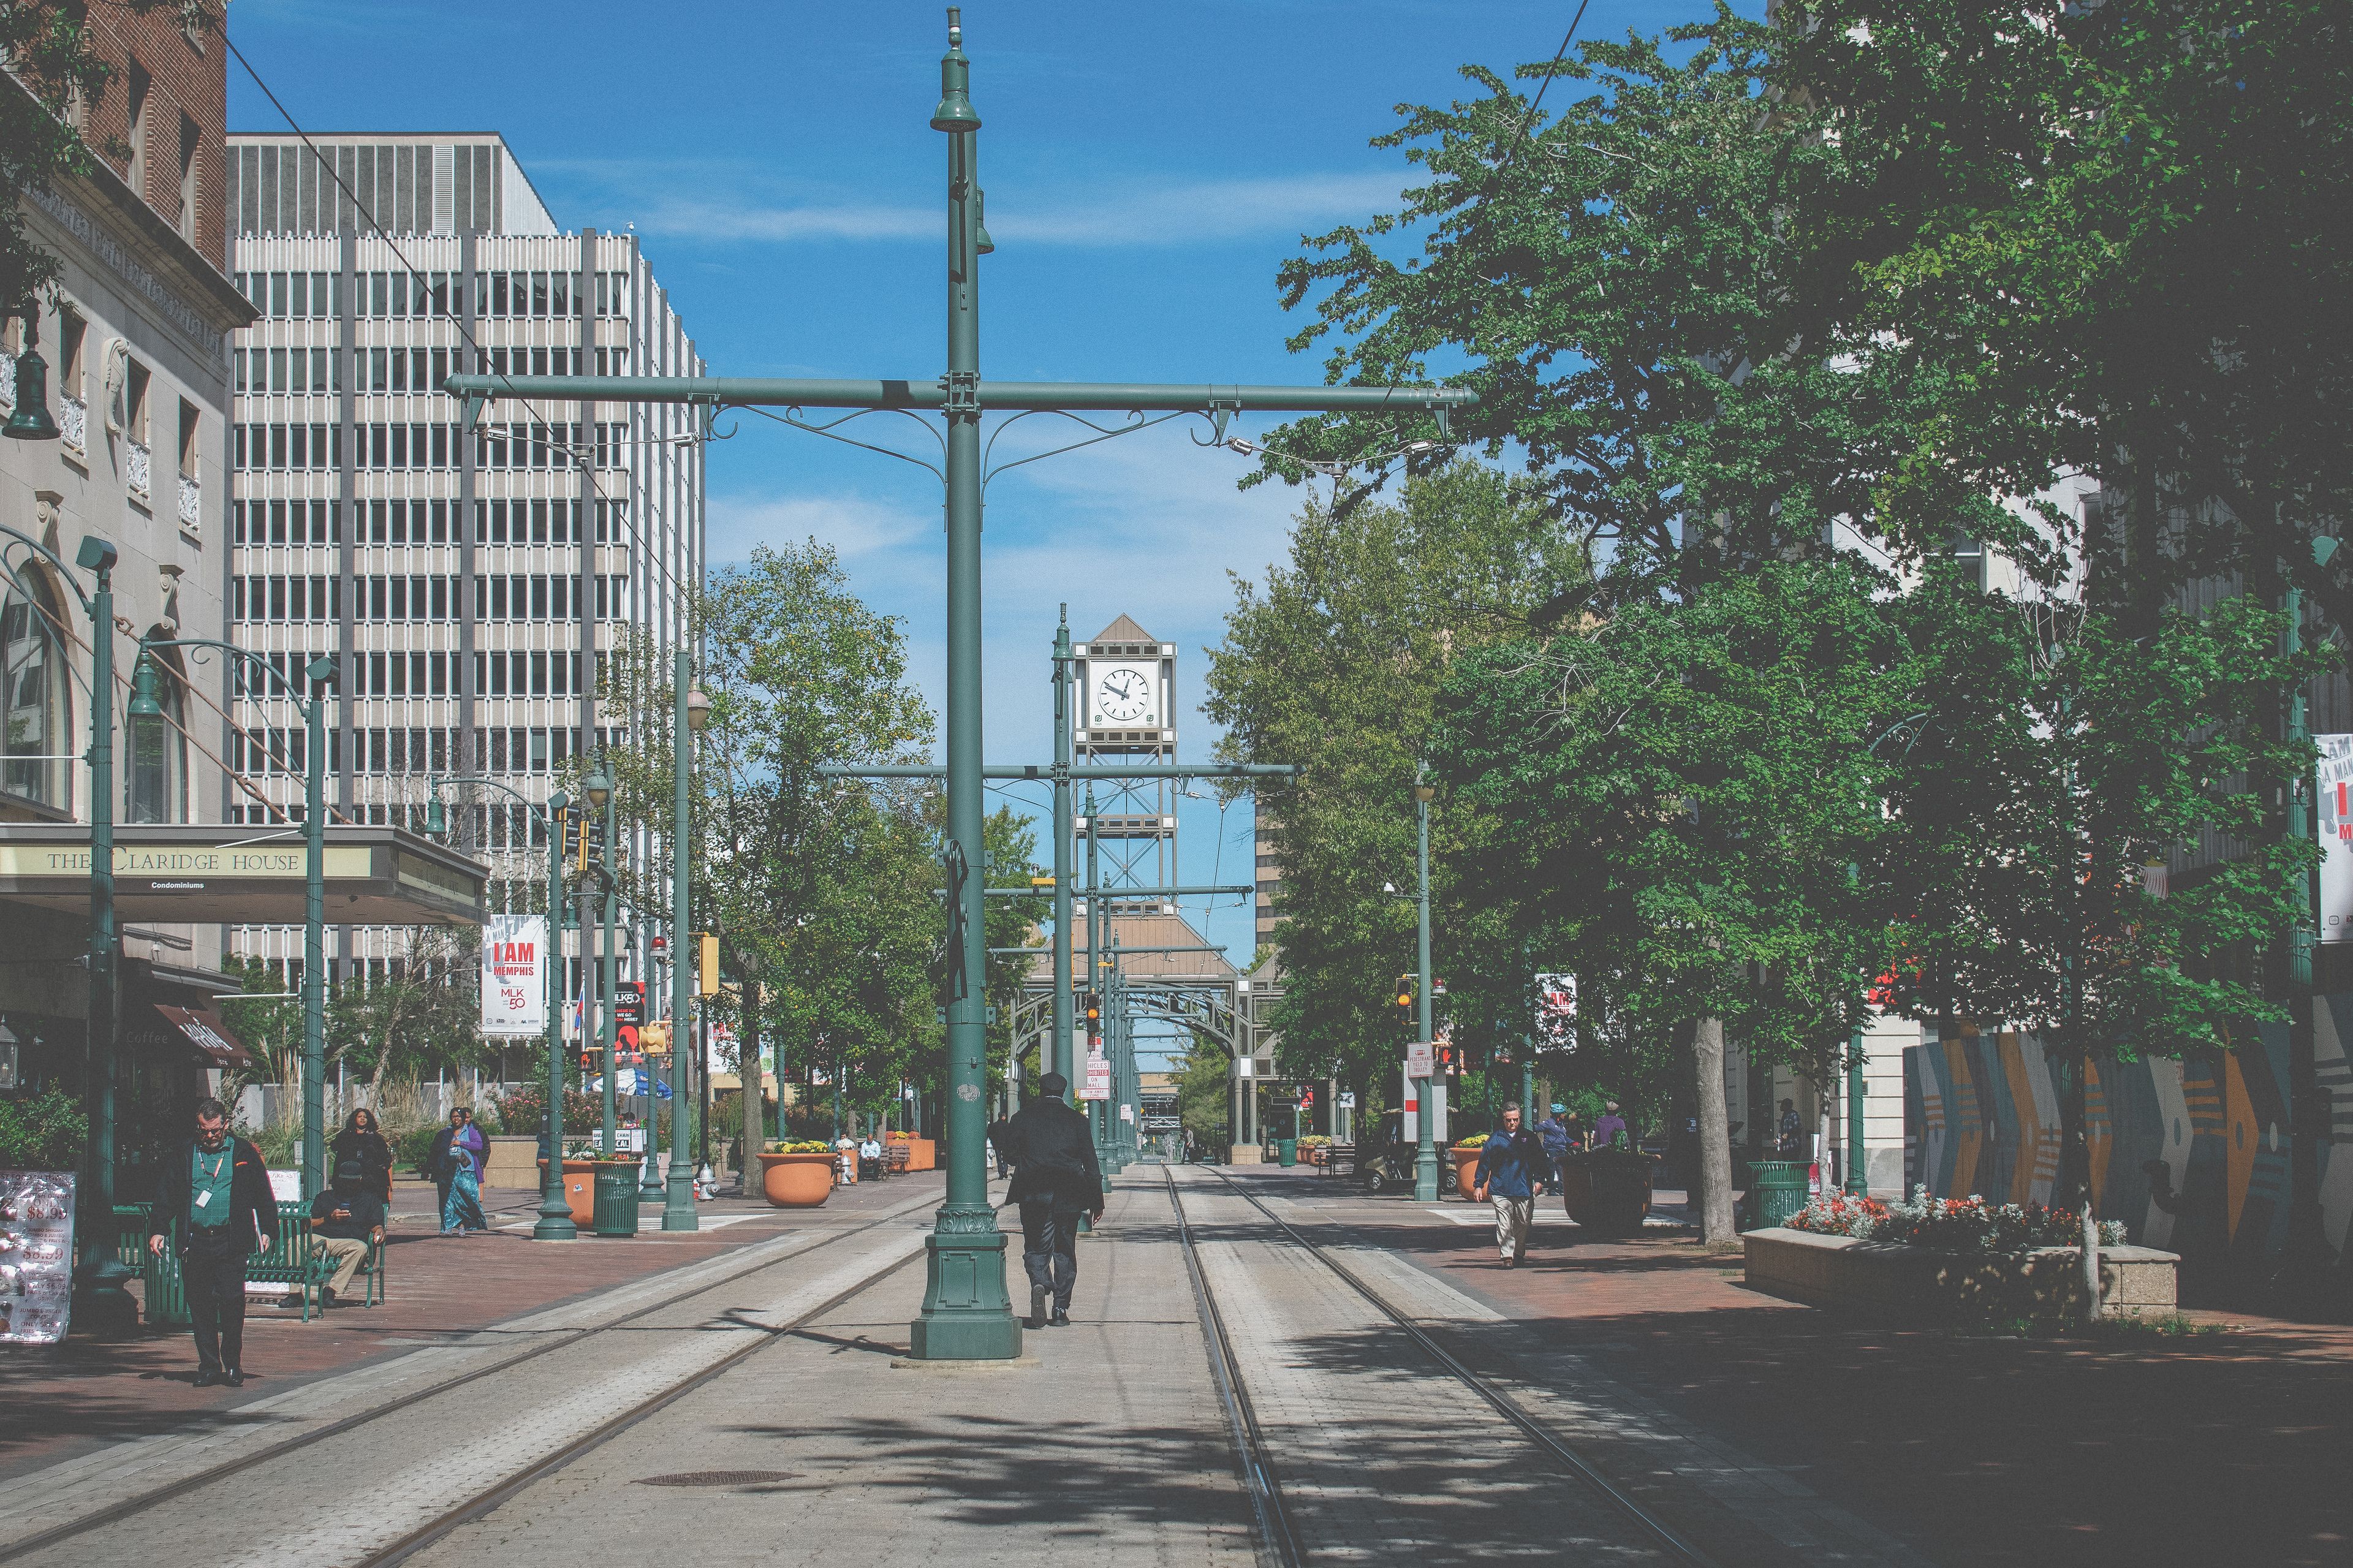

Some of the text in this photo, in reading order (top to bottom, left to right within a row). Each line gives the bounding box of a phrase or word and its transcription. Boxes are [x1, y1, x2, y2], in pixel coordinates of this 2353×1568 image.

[2337, 782, 2348, 816] I
[48, 846, 299, 871] THE CLARIDGE HOUSE
[494, 942, 534, 962] I AM
[494, 966, 534, 976] MEMPHIS
[501, 988, 525, 998] MLK
[509, 998, 525, 1010] 50
[126, 1031, 169, 1044] Coffee
[27, 1205, 68, 1222] $8.99
